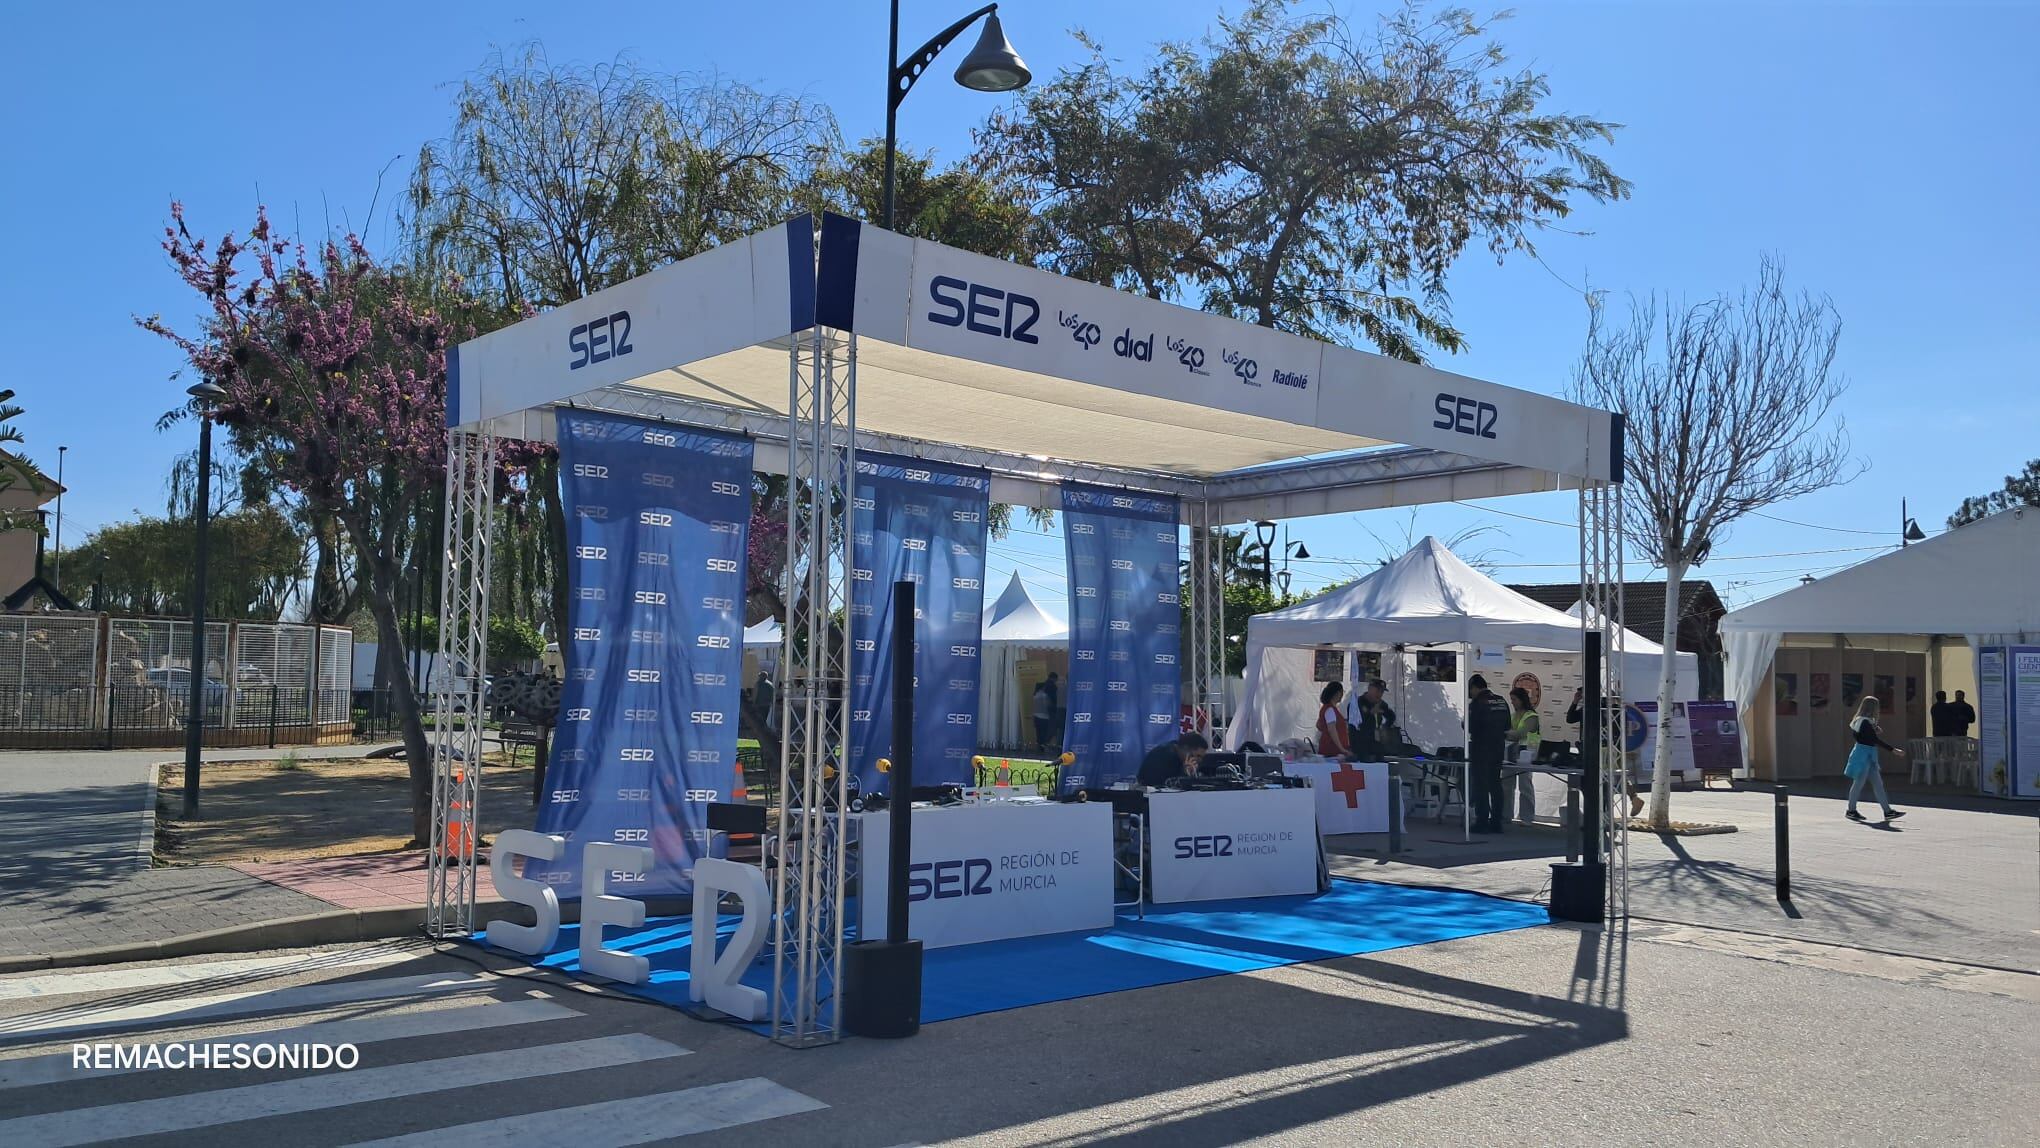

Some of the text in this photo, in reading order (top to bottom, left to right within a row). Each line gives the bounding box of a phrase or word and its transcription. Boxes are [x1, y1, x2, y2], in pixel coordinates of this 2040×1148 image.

[928, 275, 1040, 345] SER
[569, 310, 633, 370] SER
[1073, 322, 1101, 350] 40
[1113, 327, 1154, 363] dial
[1179, 346, 1205, 372] 40
[1234, 358, 1258, 385] 40
[1272, 368, 1308, 390] Radiolé
[1433, 393, 1498, 439] SER
[643, 432, 676, 447] SER
[574, 463, 608, 479] SER
[905, 469, 931, 483] SER
[641, 472, 674, 488] SER
[712, 481, 741, 497] SER
[1112, 497, 1133, 509] SER
[640, 512, 672, 527] SER
[953, 511, 980, 523] SER
[1072, 523, 1095, 535] SER
[1157, 533, 1176, 543] SER
[903, 539, 927, 551] SER
[576, 545, 607, 560] SER
[638, 551, 669, 566] SER
[706, 558, 737, 573] SER
[1112, 559, 1133, 570] SER
[852, 569, 873, 581] SER
[953, 578, 980, 590] SER
[635, 591, 666, 605] SER
[1076, 587, 1096, 597] SER
[1158, 593, 1178, 604] SER
[702, 597, 733, 611] SER
[1110, 620, 1130, 631] SER
[631, 630, 664, 644] SER
[696, 635, 730, 649] SER
[951, 646, 976, 657] SER
[1077, 650, 1095, 660] SER
[1155, 654, 1175, 664] SER
[627, 669, 660, 683] SER
[693, 673, 726, 686] SER
[1107, 681, 1127, 692] SER
[566, 708, 591, 721] SER
[624, 709, 657, 722] SER
[690, 711, 723, 724] SER
[947, 713, 972, 725] SER
[1073, 713, 1092, 723] SER
[1149, 714, 1172, 724] SER
[1104, 743, 1122, 752] SER
[620, 749, 654, 762] SER
[687, 750, 720, 763] SER
[1065, 776, 1085, 786] SER
[551, 789, 580, 803] SER
[617, 789, 651, 801] SER
[684, 789, 718, 803] SER
[614, 829, 649, 842] SER
[1174, 835, 1233, 859] SER
[1279, 831, 1293, 841] DE
[1237, 845, 1278, 856] MURCIA
[908, 850, 1079, 902] SER REGIÓN DE
[1000, 875, 1057, 893] MURCIA
